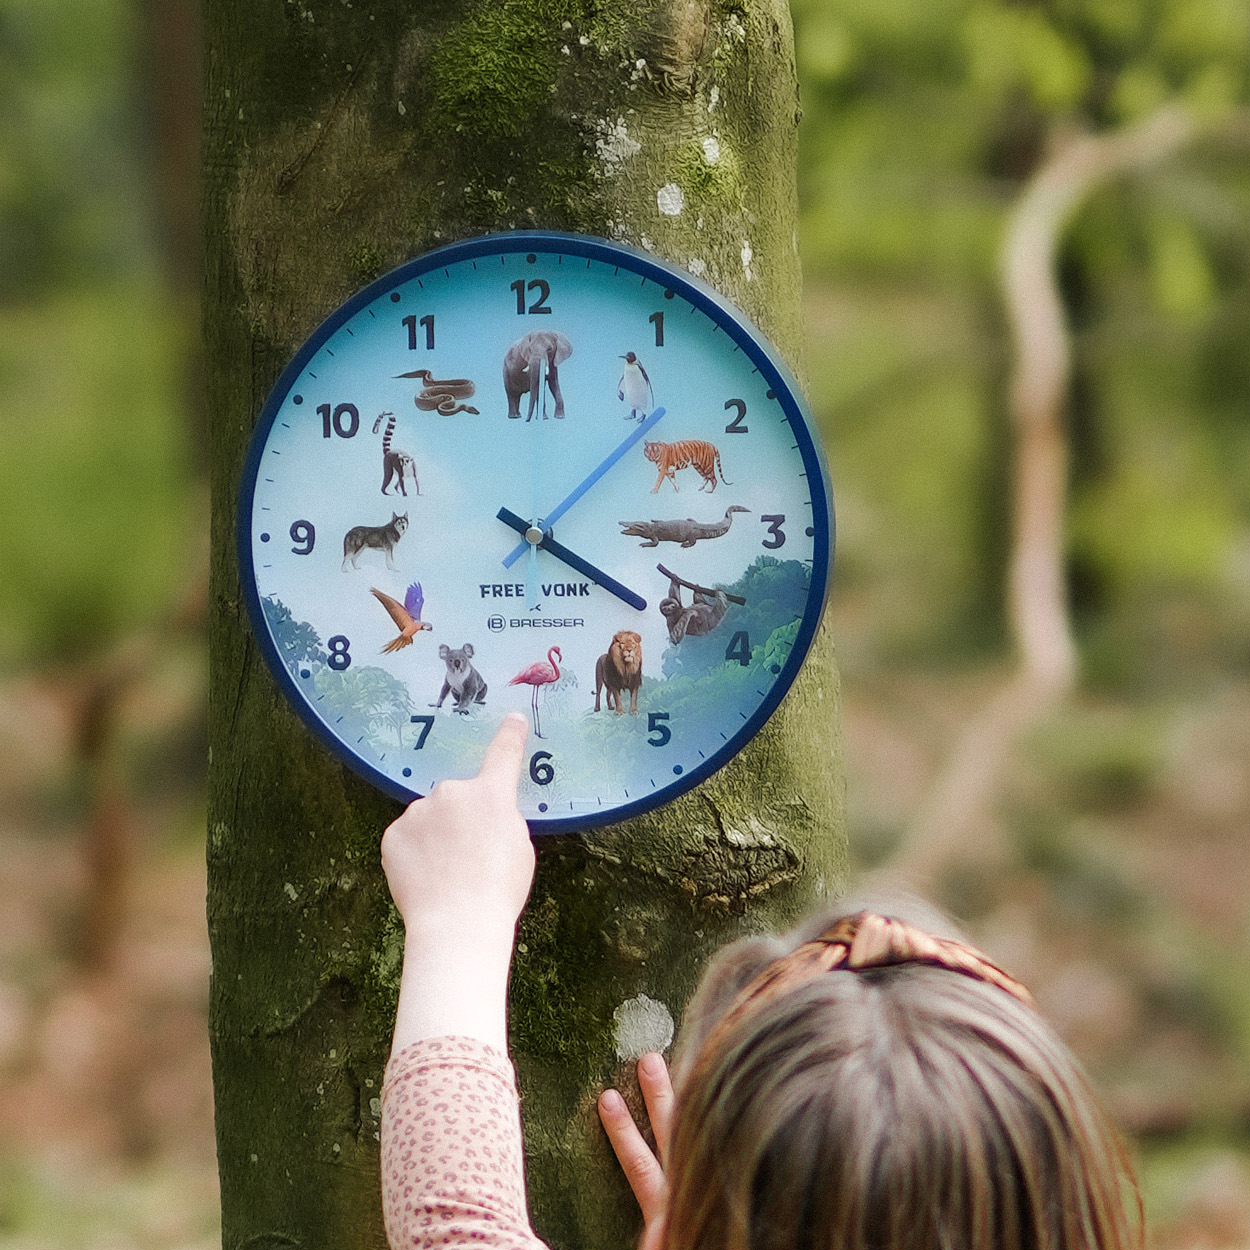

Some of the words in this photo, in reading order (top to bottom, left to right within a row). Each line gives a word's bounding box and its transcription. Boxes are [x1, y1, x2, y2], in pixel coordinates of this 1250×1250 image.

[510, 279, 552, 315] 12
[402, 315, 435, 350] 11
[649, 312, 665, 347] 1
[316, 403, 360, 438] 10
[725, 399, 749, 434] 2
[289, 520, 316, 555] 9
[761, 515, 787, 550] 3
[541, 582, 590, 598] VONK
[510, 618, 585, 628] BRESSER
[328, 635, 352, 671] 8
[725, 631, 753, 667] 4
[411, 716, 435, 751] 7
[648, 712, 672, 747] 5
[530, 751, 555, 786] 6
